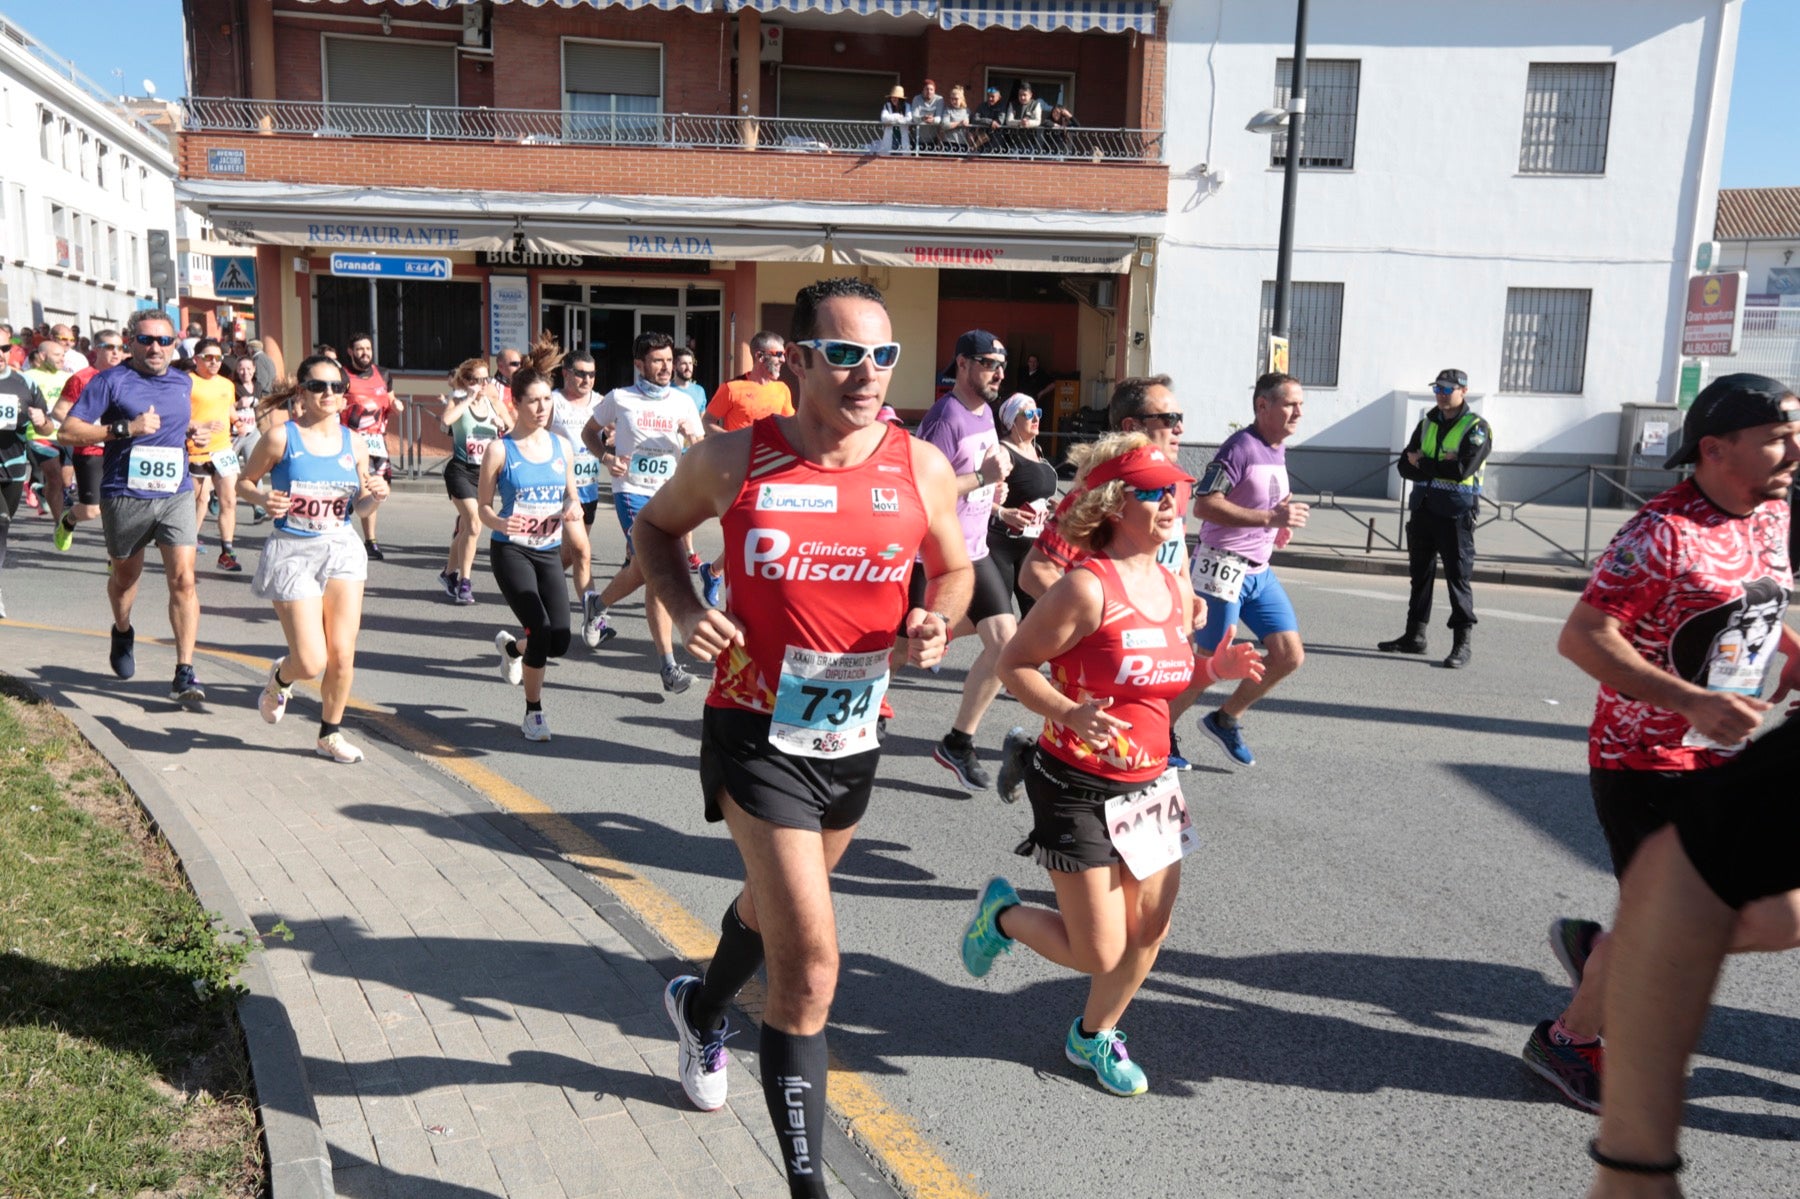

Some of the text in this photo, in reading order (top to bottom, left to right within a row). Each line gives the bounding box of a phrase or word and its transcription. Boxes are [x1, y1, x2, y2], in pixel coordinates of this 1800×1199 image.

[308, 224, 460, 246] RESTAURANTE
[627, 235, 714, 255] PARADA
[334, 259, 429, 273] Granada A-44
[486, 250, 584, 267] BICHITOS
[1687, 309, 1734, 324] Gran apertura
[1684, 341, 1729, 354] ALBOLOTE
[637, 418, 673, 429] COLINAS
[139, 460, 176, 478] 985
[638, 457, 669, 474] 605
[292, 497, 345, 517] 2076
[744, 527, 911, 583] Polisalud
[798, 541, 867, 557] Clínicas
[1199, 558, 1241, 583] 3167
[816, 655, 839, 667] GRAN
[839, 656, 864, 668] PREMIO
[801, 685, 874, 726] 734
[777, 1075, 814, 1176] kalenji
